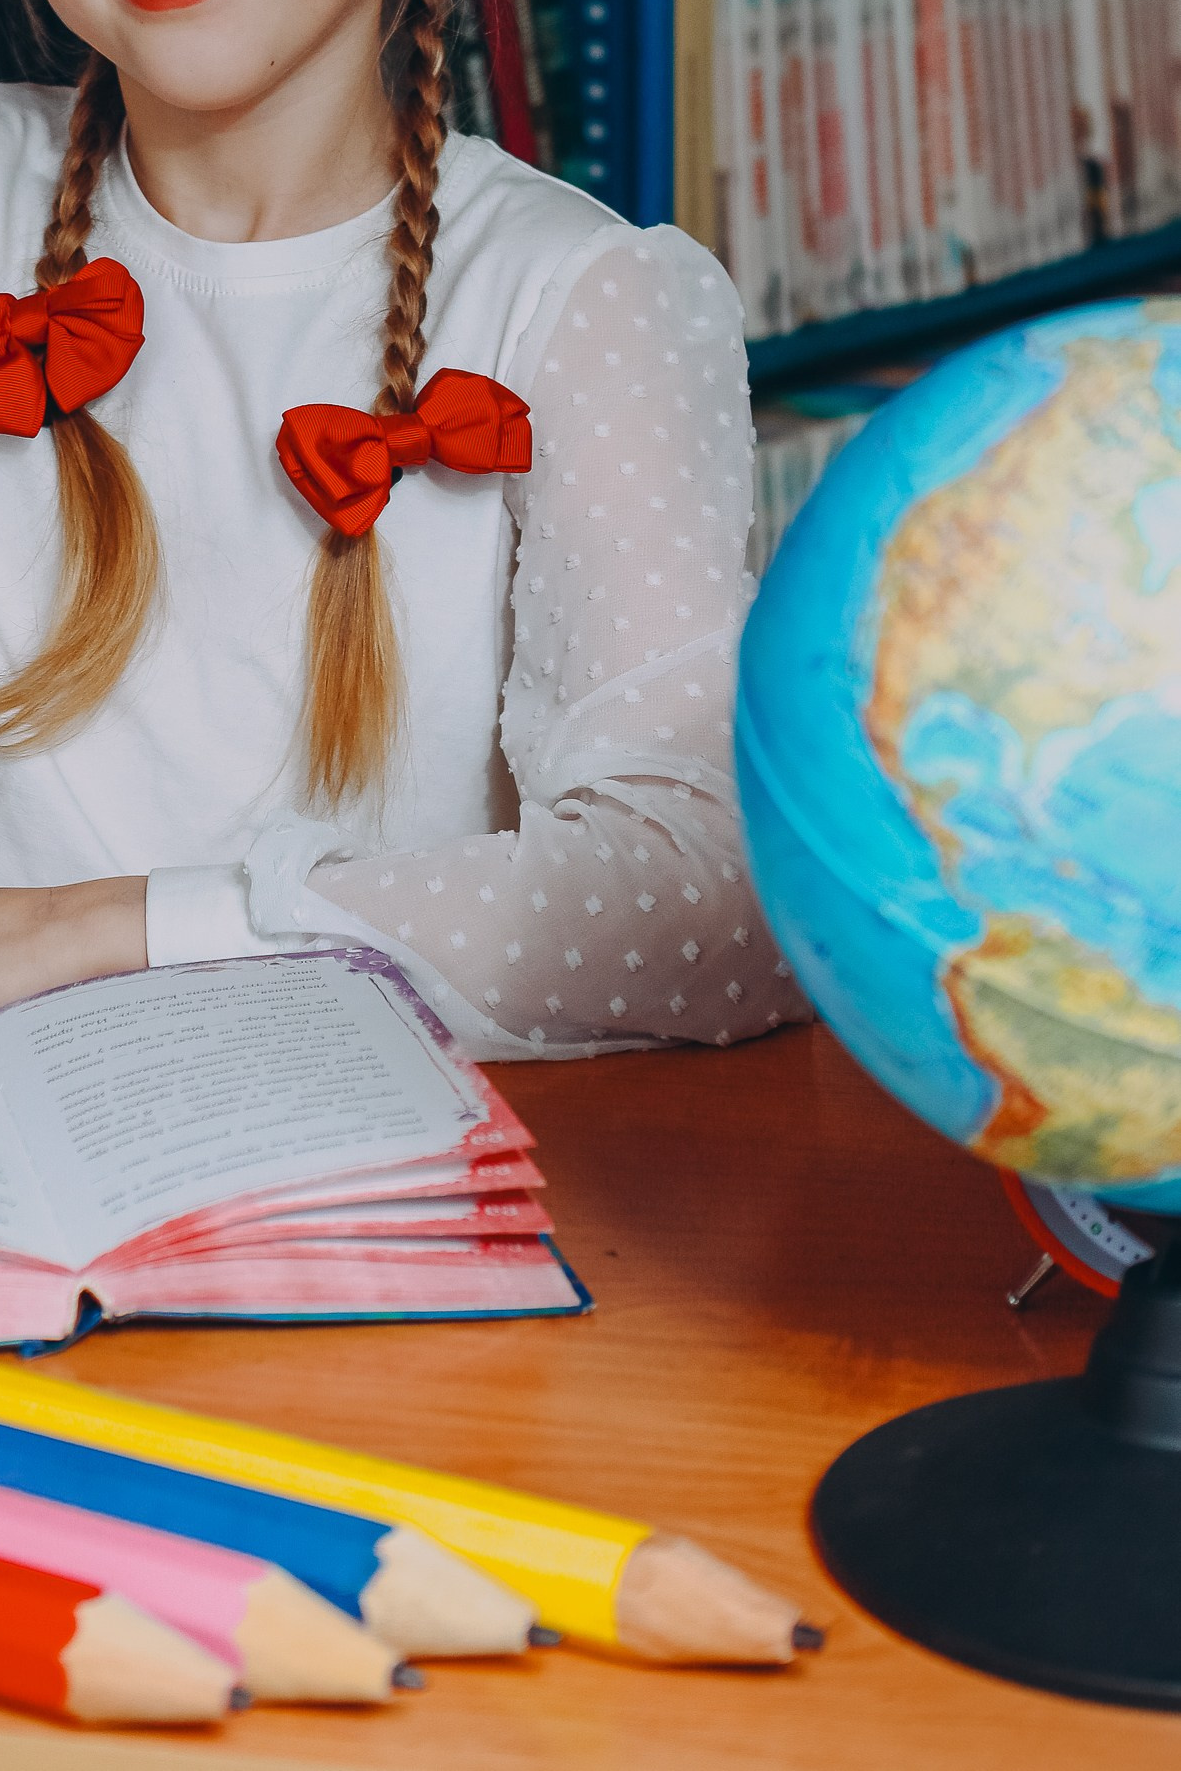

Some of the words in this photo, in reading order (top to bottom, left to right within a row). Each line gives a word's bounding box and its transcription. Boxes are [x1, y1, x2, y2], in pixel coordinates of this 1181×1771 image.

[281, 969, 316, 977] ница?
[182, 985, 235, 998] уверена.
[256, 983, 326, 994] уверенная,
[135, 994, 176, 1005] Какая,
[199, 995, 220, 1004] так
[228, 991, 249, 999] что
[168, 999, 192, 1008] оно
[234, 996, 293, 1006] Конечно,
[267, 1002, 309, 1010] носом.
[54, 1001, 130, 1027] собственно,
[114, 1007, 144, 1020] есть.
[166, 1006, 205, 1018] видят,
[283, 1006, 343, 1017] спросила
[80, 1018, 106, 1029] Или
[80, 1018, 137, 1039] ответила
[27, 1024, 49, 1037] раз-
[30, 1026, 72, 1046] прики-
[109, 1035, 150, 1051] прямо
